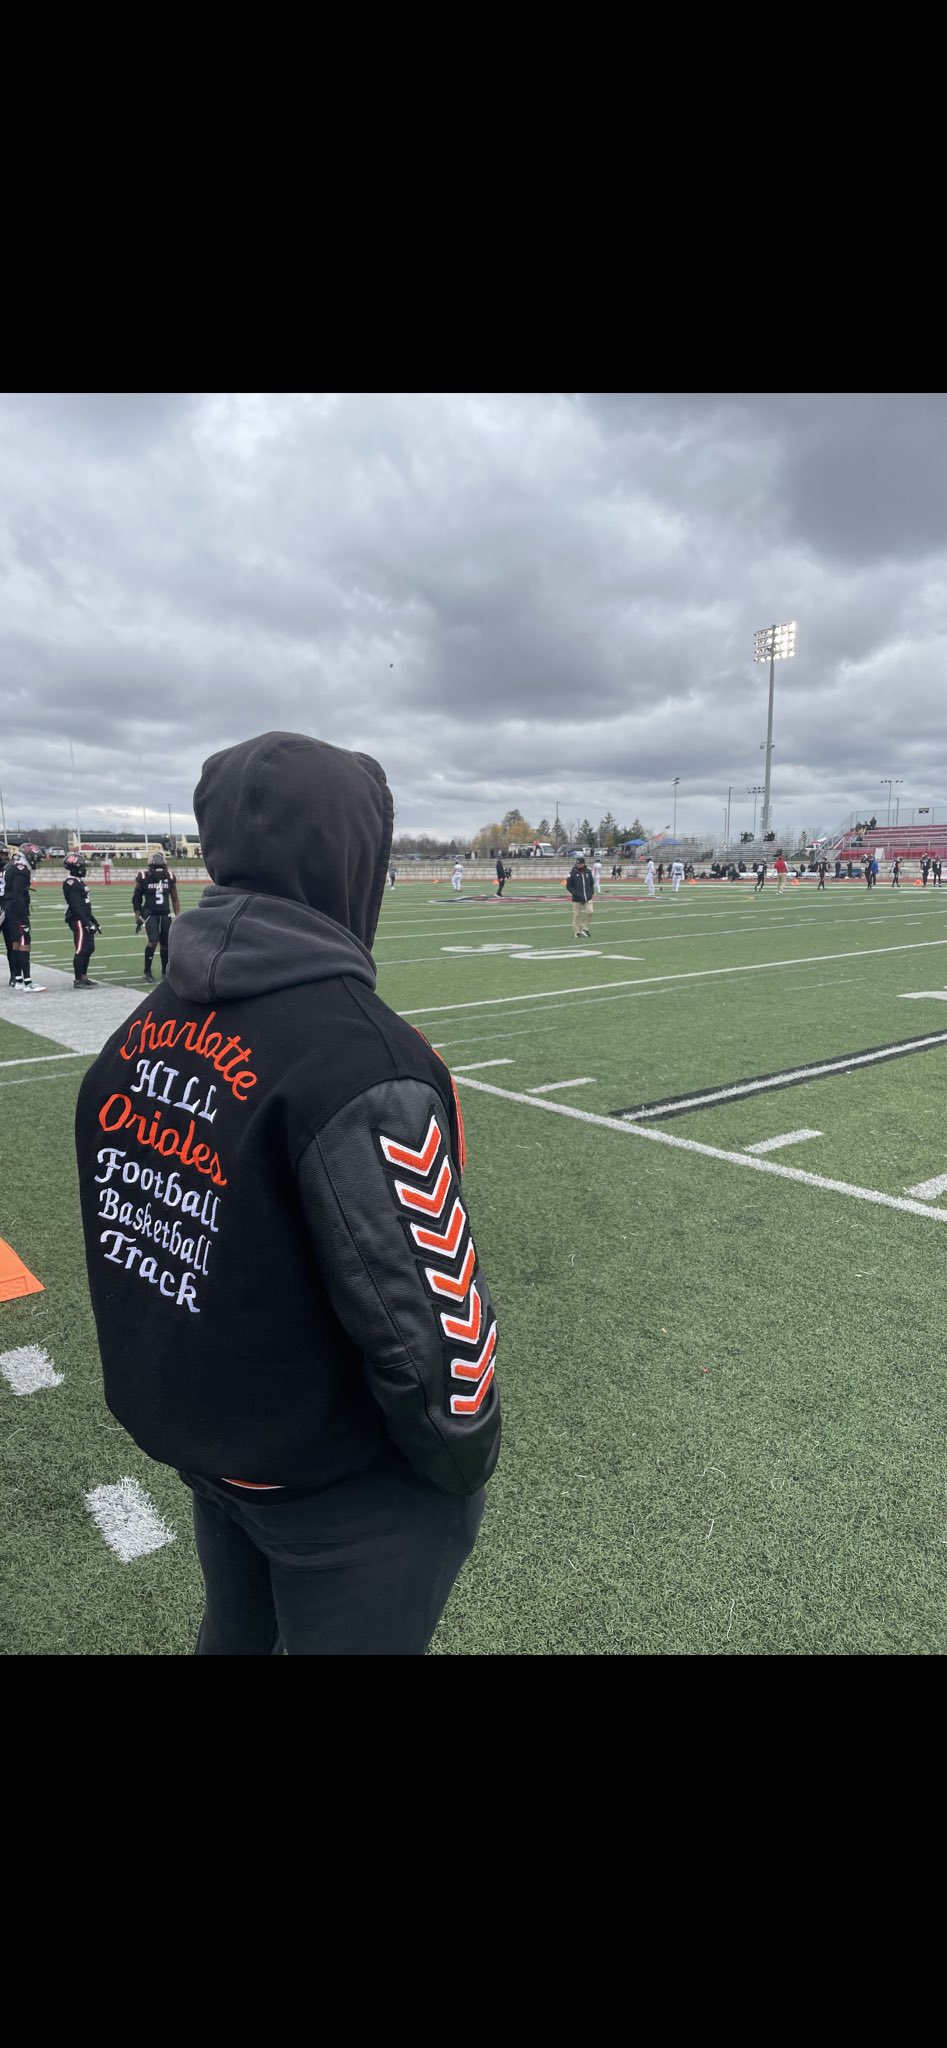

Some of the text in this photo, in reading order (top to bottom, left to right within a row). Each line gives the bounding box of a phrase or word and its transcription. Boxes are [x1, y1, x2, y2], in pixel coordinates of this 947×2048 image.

[155, 889, 164, 905] 5
[119, 1011, 258, 1101] Charlotte
[130, 1058, 218, 1124] HILL
[98, 1093, 228, 1186] Orioles
[94, 1147, 221, 1233] Football
[97, 1187, 213, 1276] Basketball
[99, 1229, 201, 1313] Track
